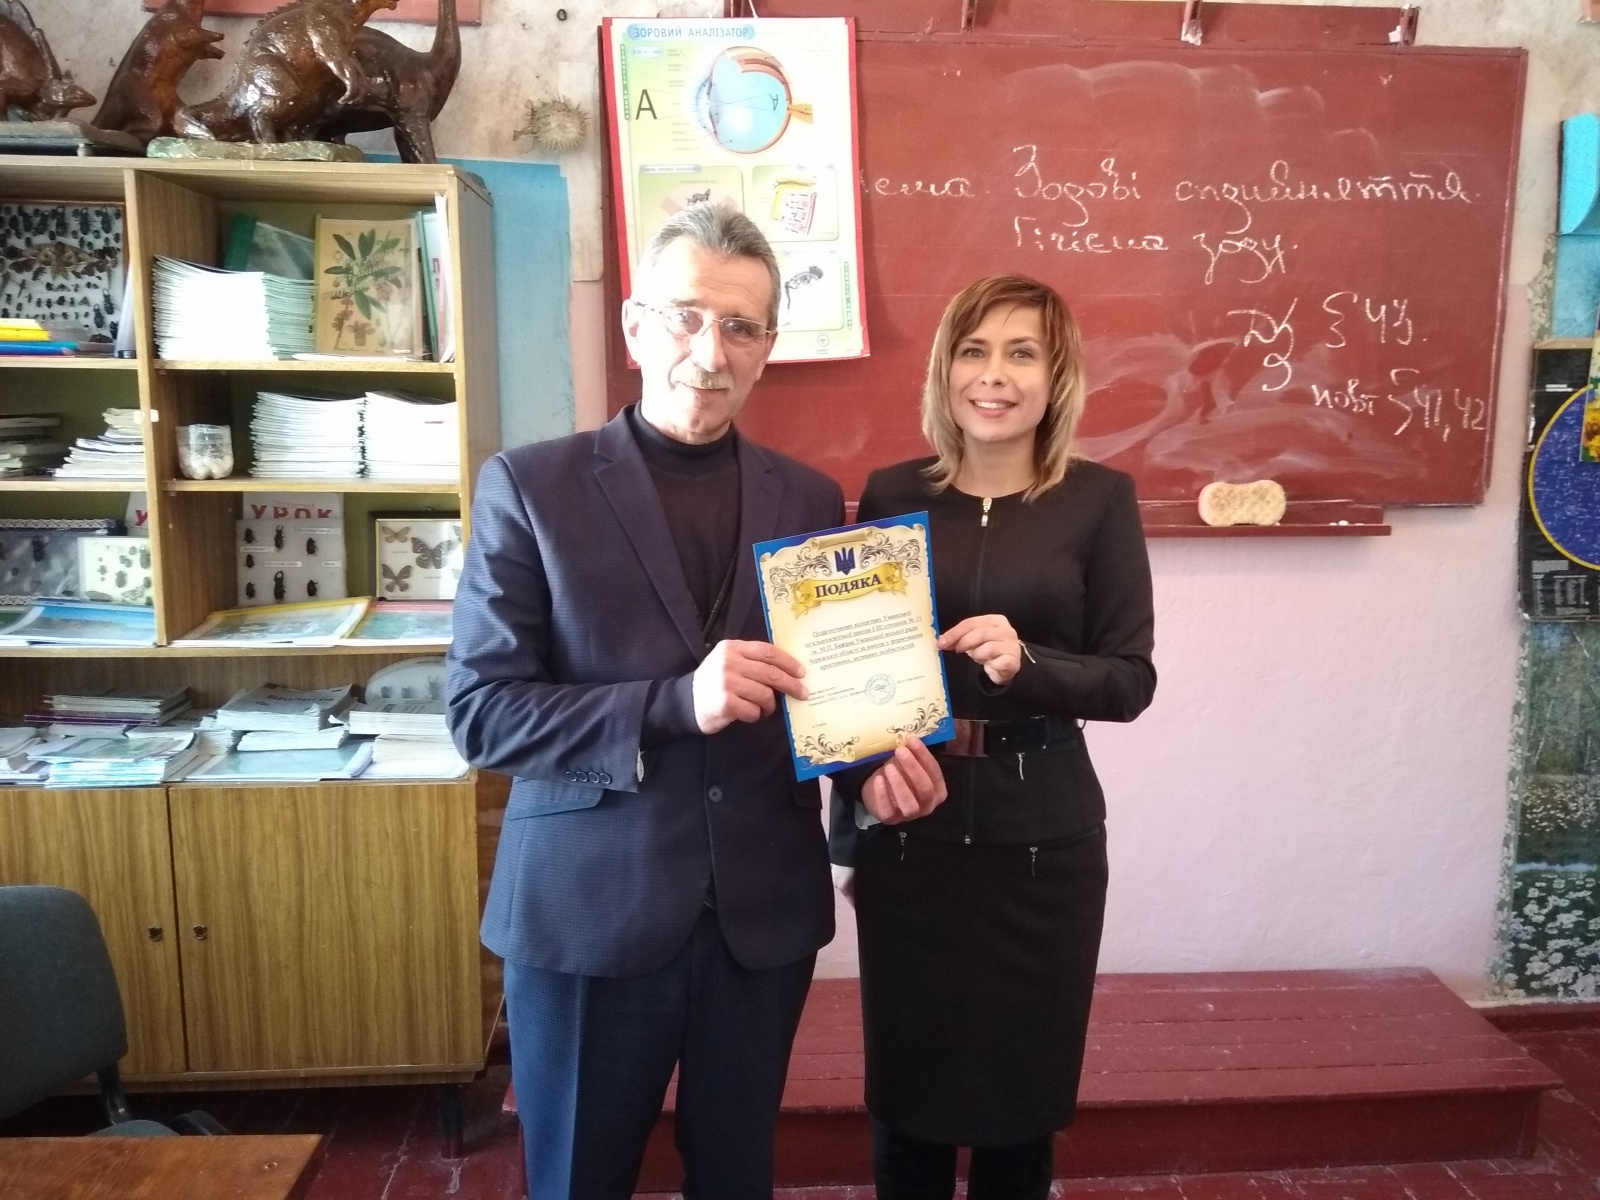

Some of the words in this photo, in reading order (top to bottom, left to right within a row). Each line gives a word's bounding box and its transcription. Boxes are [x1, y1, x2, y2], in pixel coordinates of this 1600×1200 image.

[634, 26, 682, 37] ЗОРОВИЙ
[688, 26, 749, 38] АНАЛІЗАТОР
[814, 572, 883, 599] ПОДЯКА
